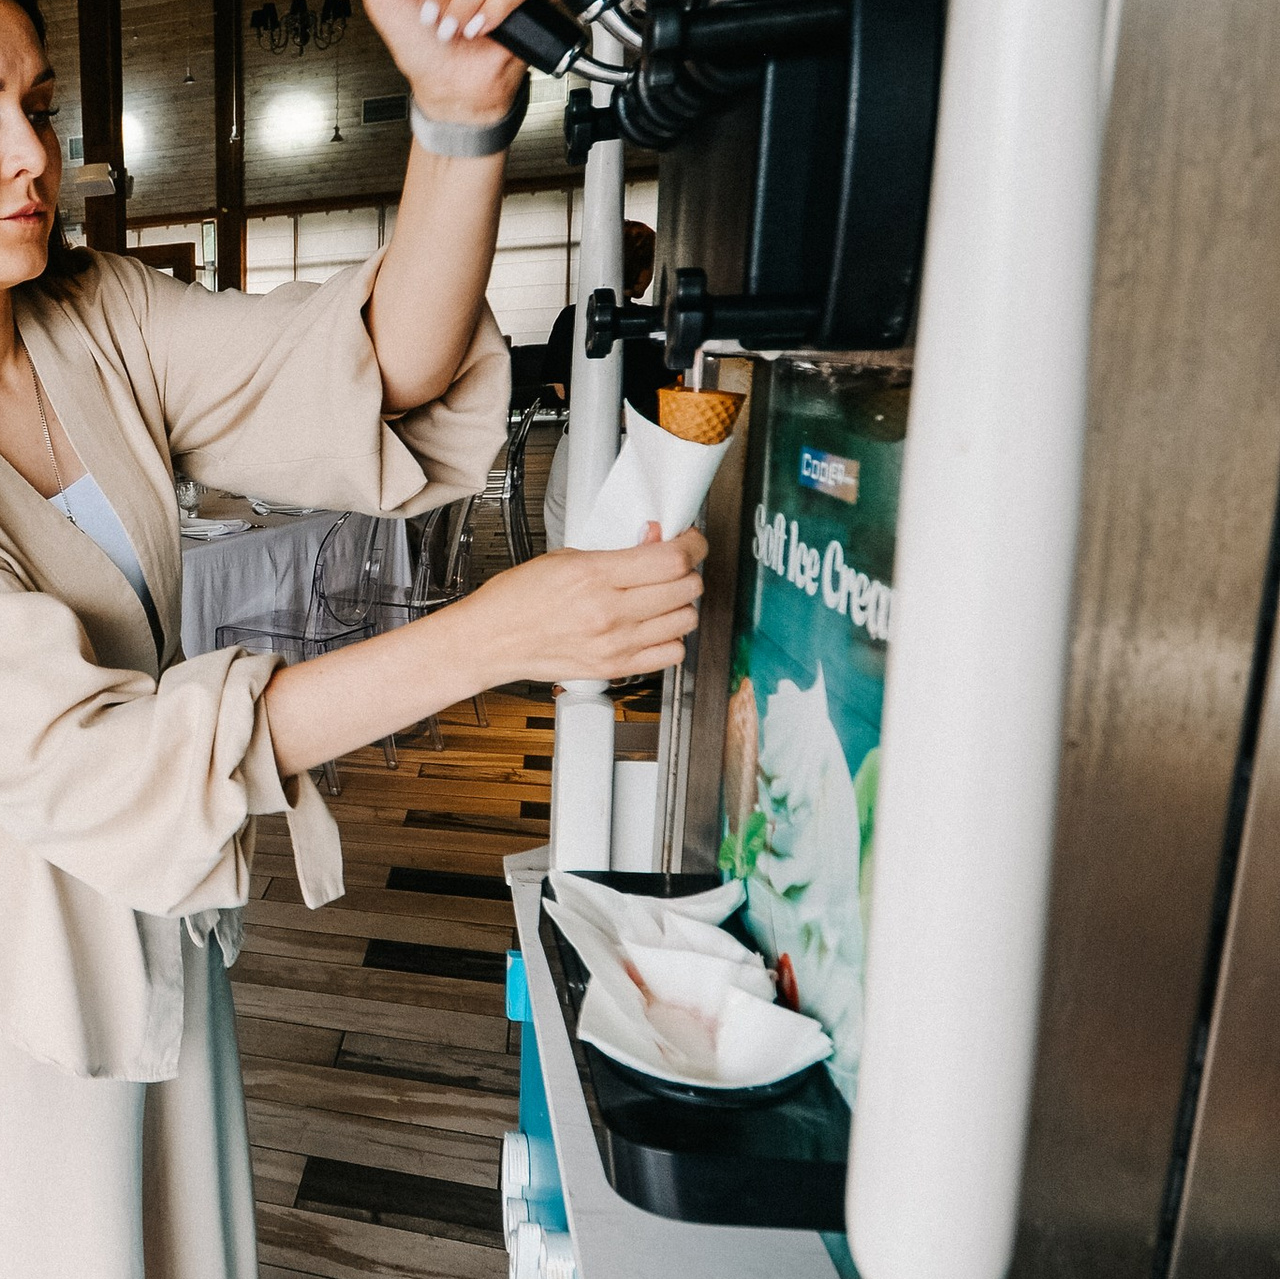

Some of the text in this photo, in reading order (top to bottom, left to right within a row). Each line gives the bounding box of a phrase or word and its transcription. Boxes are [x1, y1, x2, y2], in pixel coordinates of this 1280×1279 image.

[753, 504, 892, 640] Soft Ice Crea
